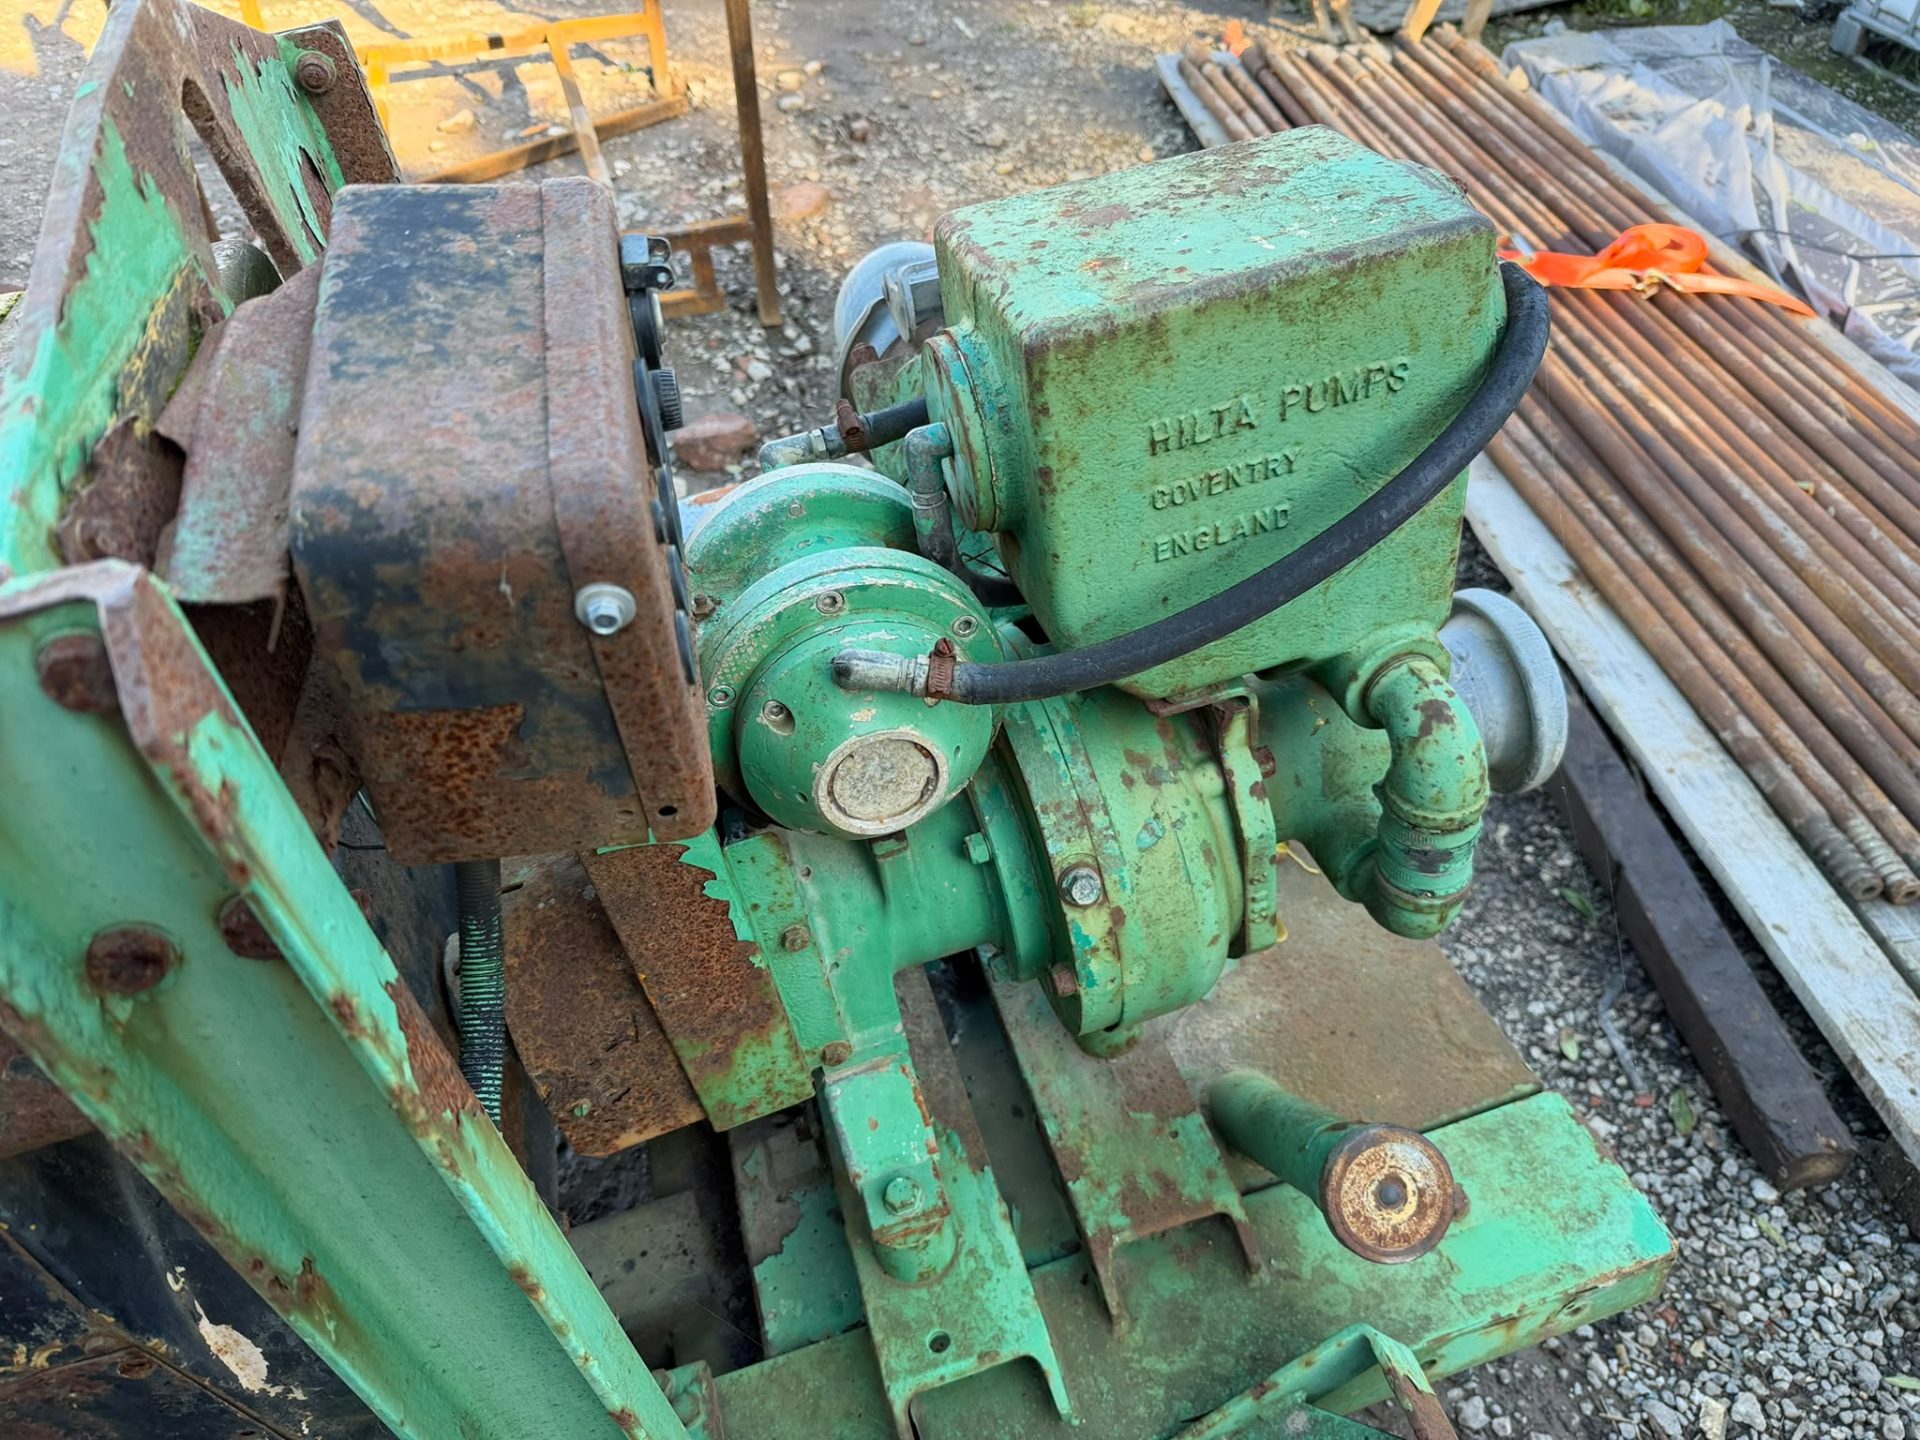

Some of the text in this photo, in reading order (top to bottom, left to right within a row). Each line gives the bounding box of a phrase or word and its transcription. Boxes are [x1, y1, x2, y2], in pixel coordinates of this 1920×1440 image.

[1149, 360, 1409, 456] HILTA PUMPS
[1151, 449, 1300, 510] COVENTRY
[1154, 503, 1292, 563] ENGLAND
